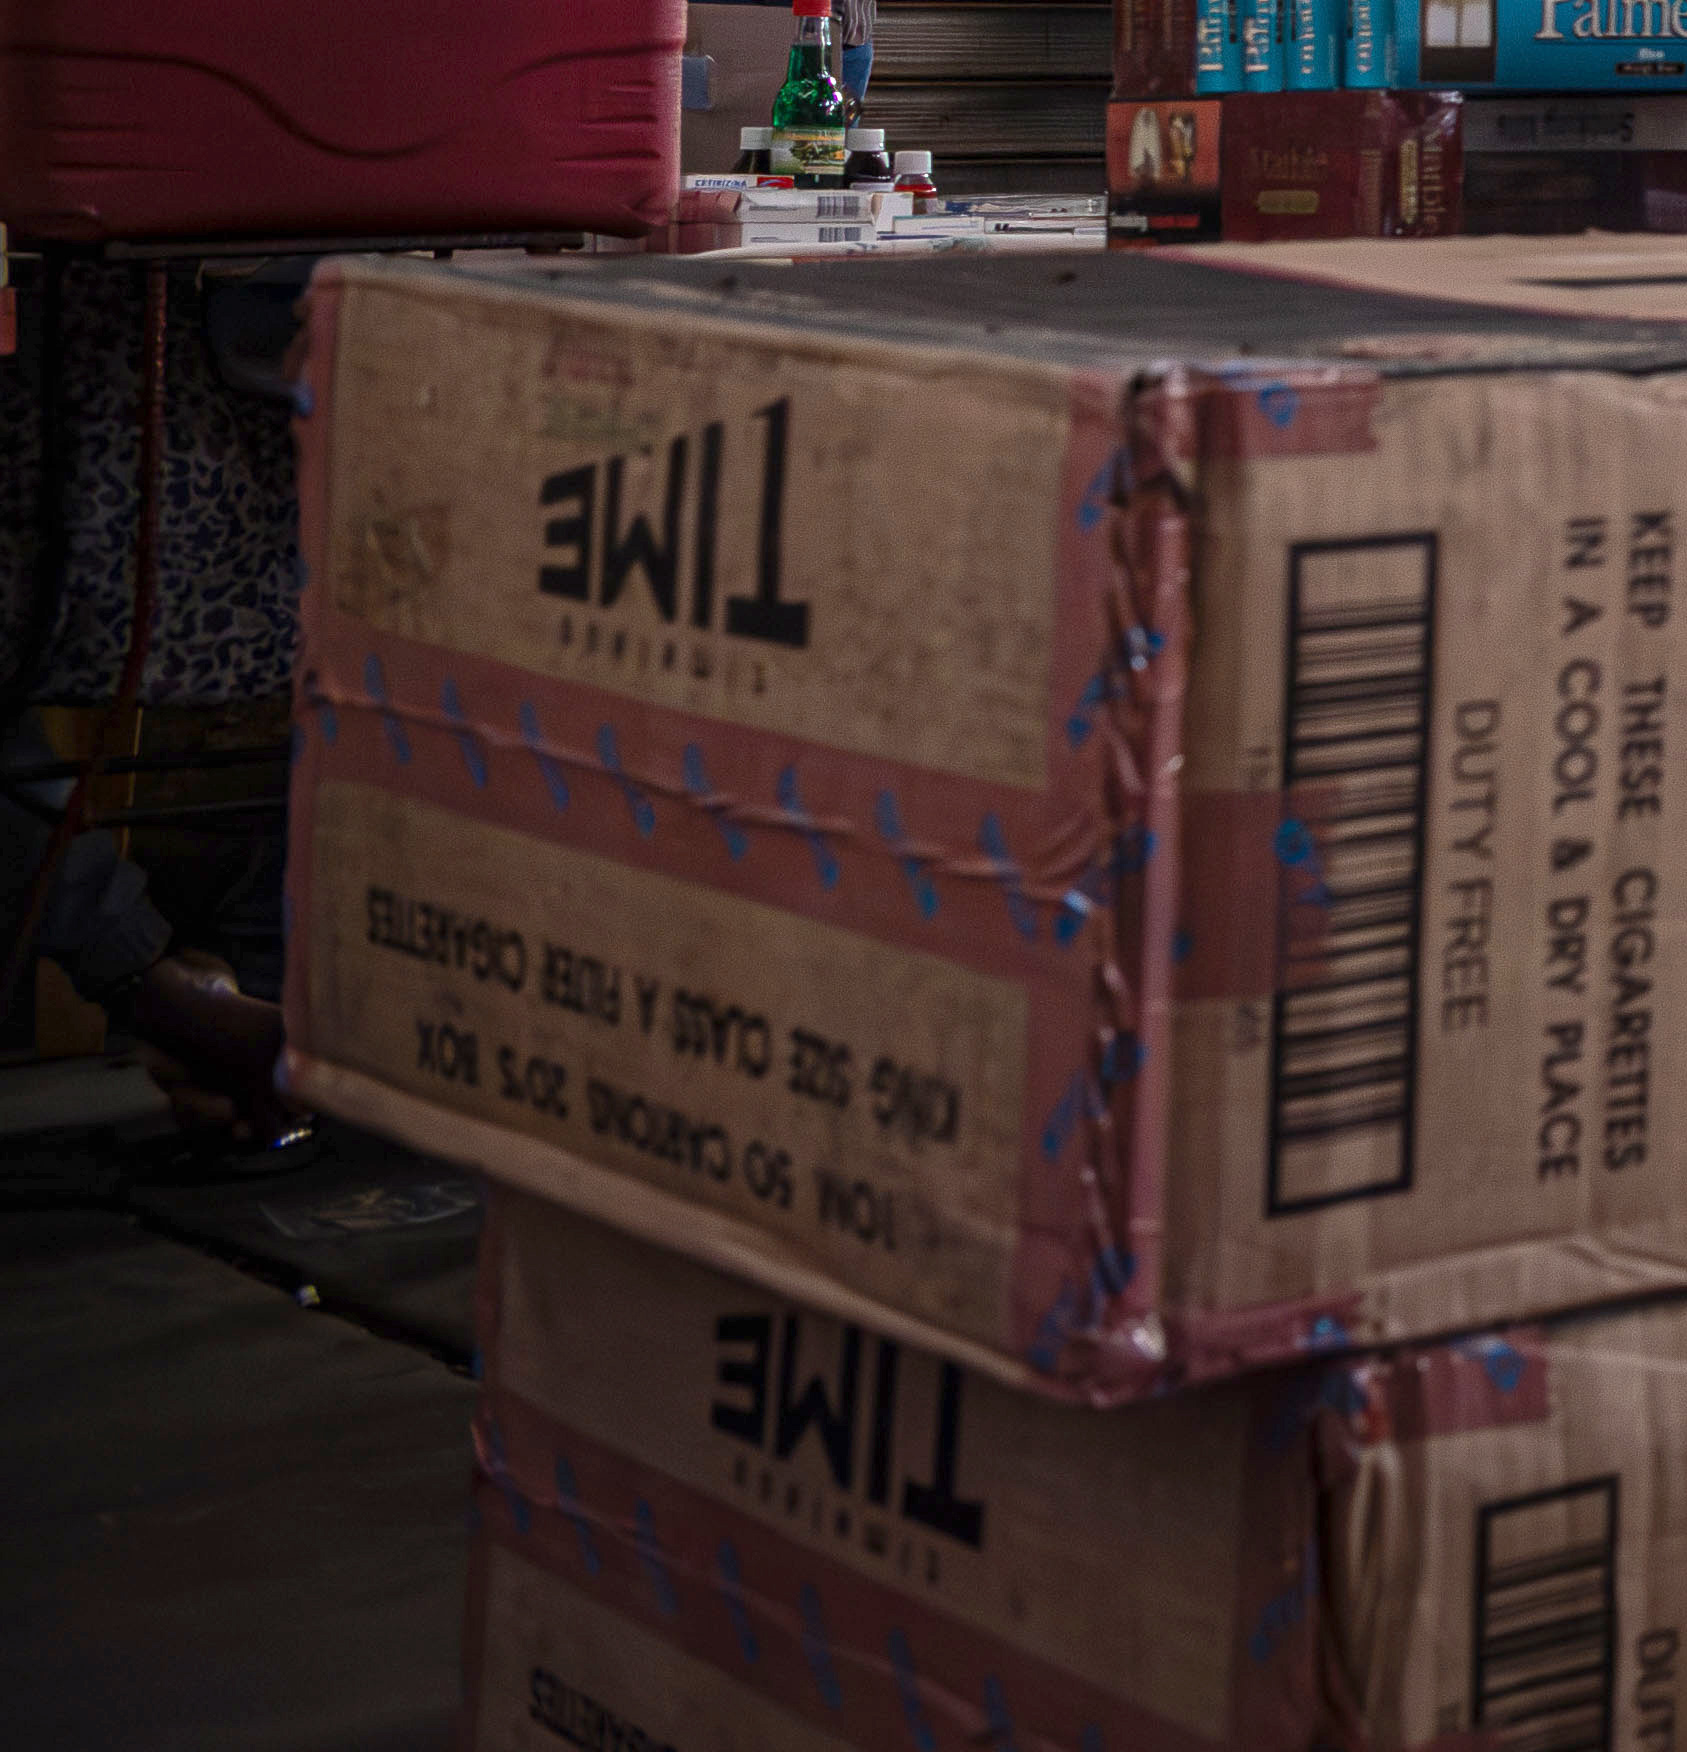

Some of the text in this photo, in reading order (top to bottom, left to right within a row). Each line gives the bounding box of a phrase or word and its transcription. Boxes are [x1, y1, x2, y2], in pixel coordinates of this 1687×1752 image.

[538, 398, 811, 648] TIME
[1440, 699, 1500, 1037] DUTY FREE
[1536, 515, 1608, 1185] IN COOL DRY PLACE
[1602, 507, 1673, 1175] KEEP THESE CIGARETTES
[364, 885, 961, 1147] KING SIZE CLASS A FILTER CIGARETTES
[414, 1019, 479, 1090] BOX
[583, 1075, 728, 1184] CARTONS
[741, 1143, 795, 1212] 50
[711, 1311, 985, 1551] TIME
